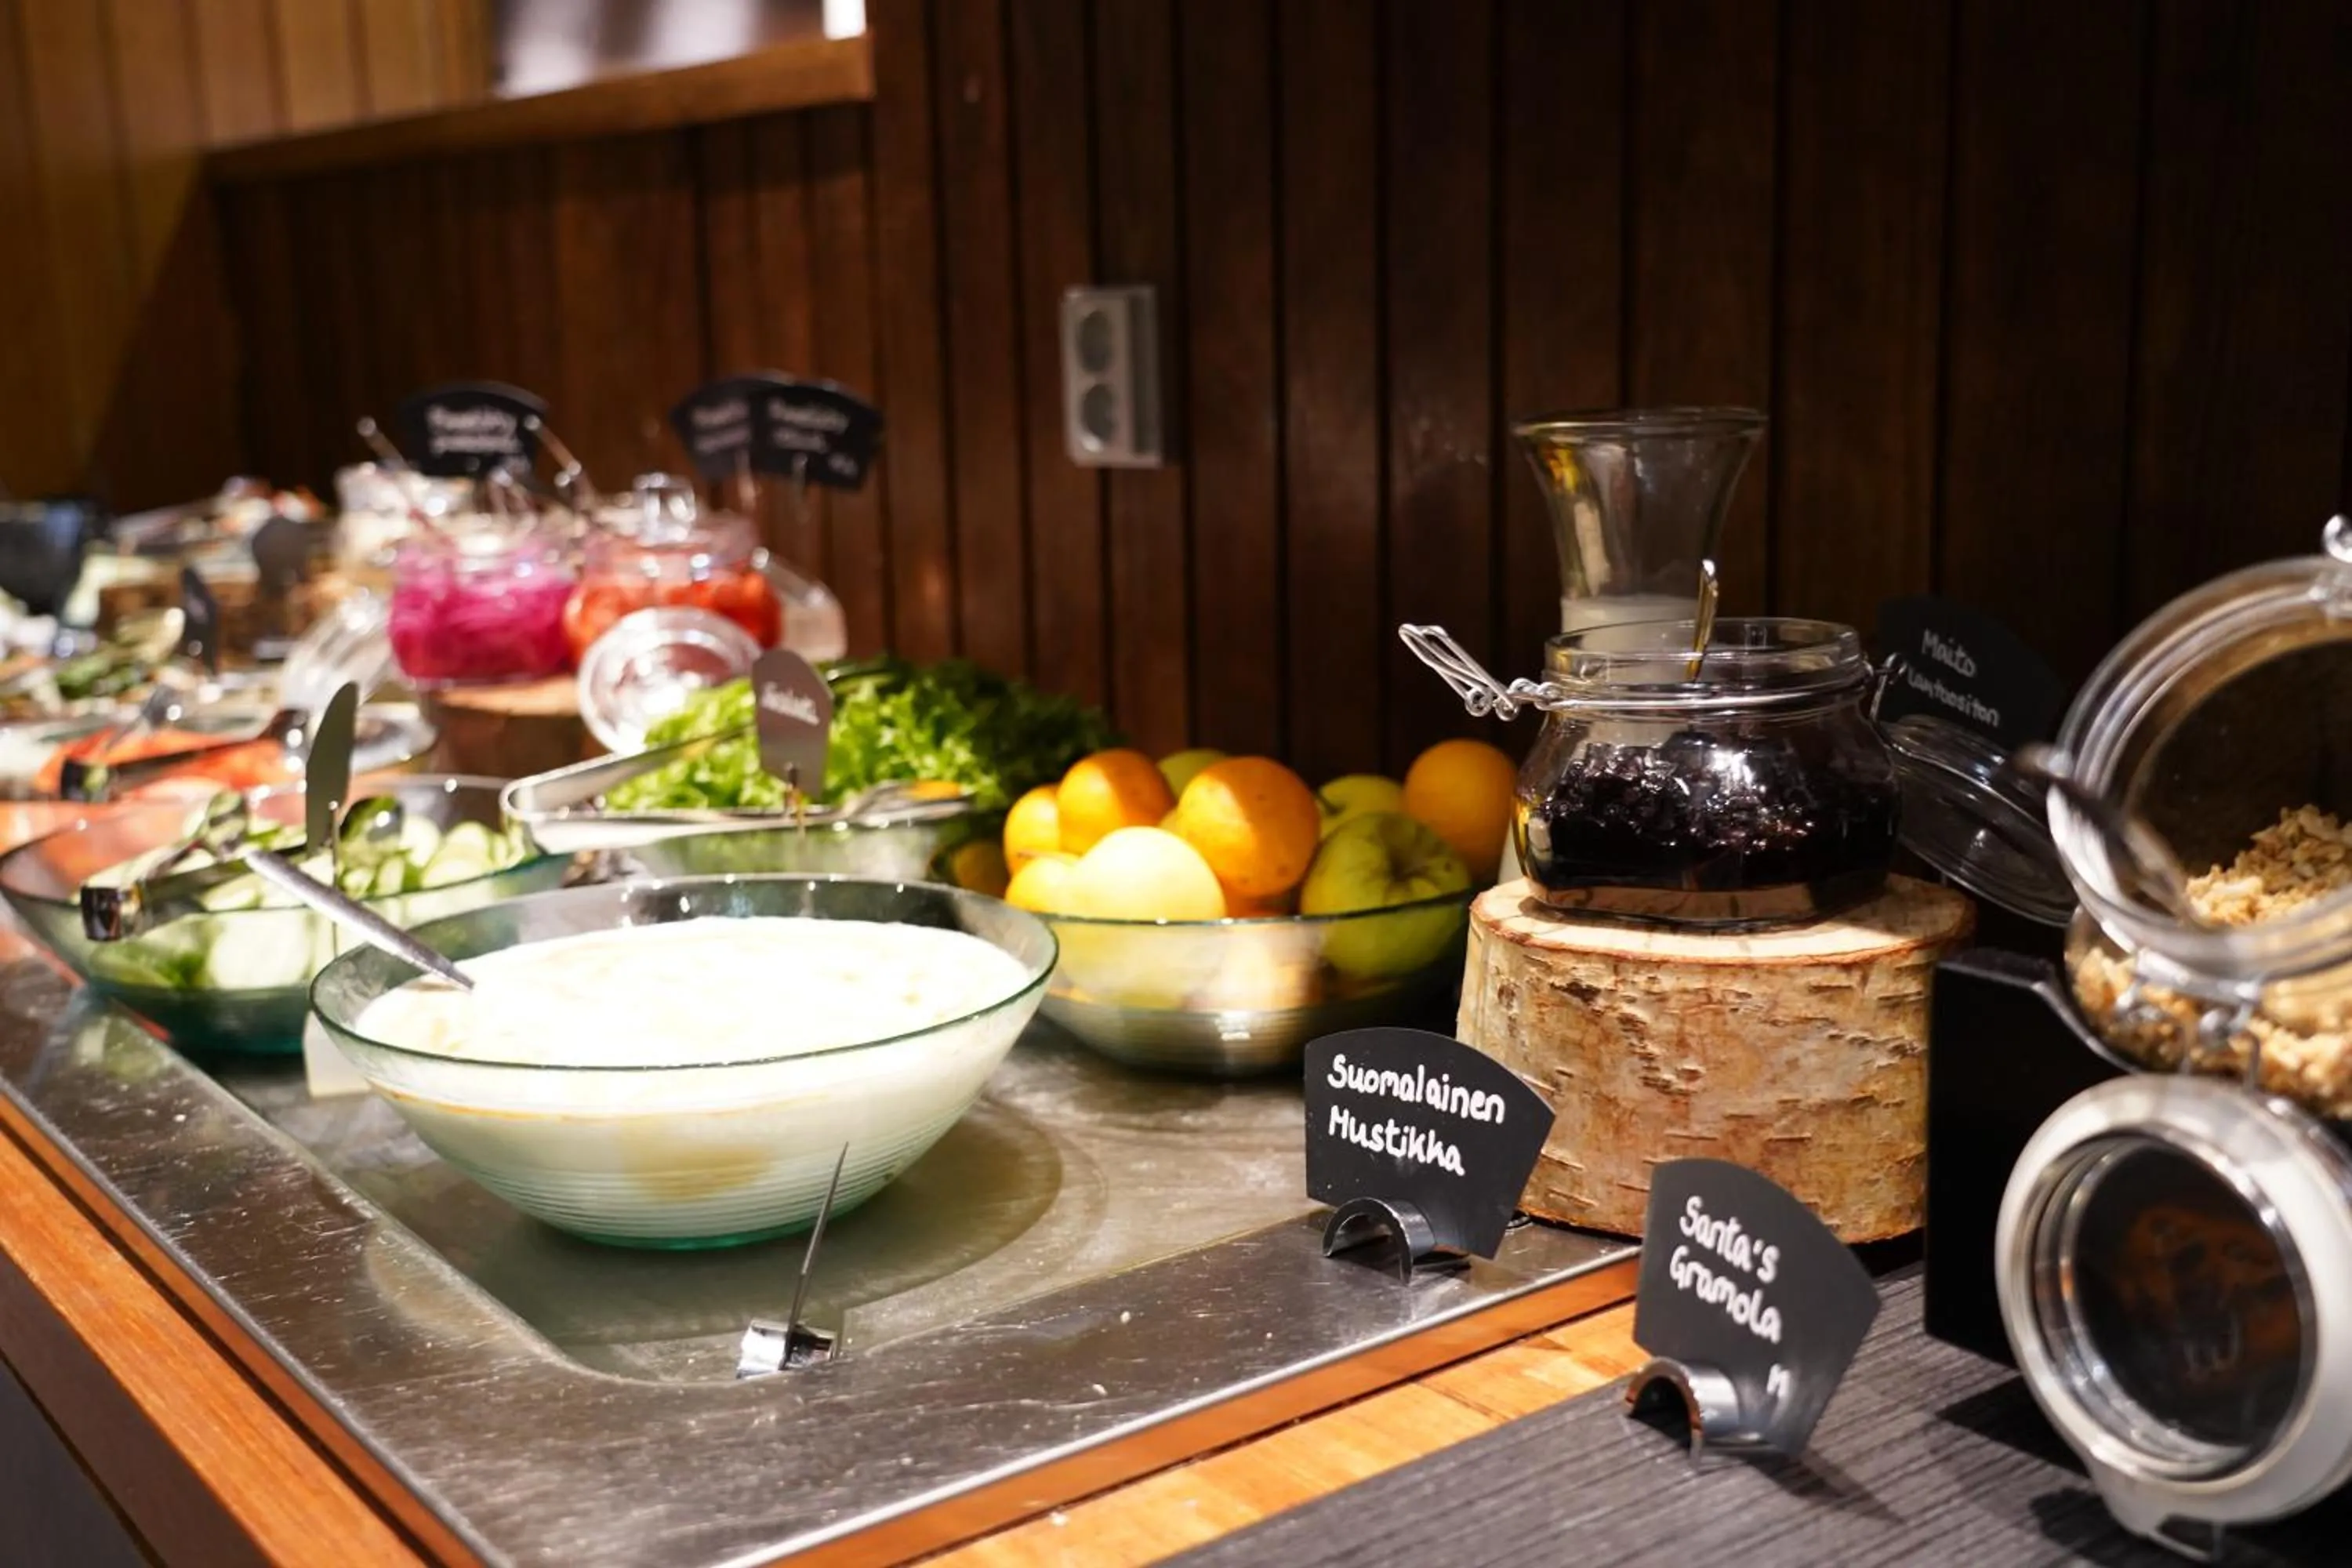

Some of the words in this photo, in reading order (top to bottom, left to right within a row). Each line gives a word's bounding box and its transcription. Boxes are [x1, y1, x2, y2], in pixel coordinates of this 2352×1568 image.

[1921, 627, 1977, 678] Maito
[1327, 1053, 1506, 1124] Suomalainen
[1328, 1104, 1466, 1176] Mustikka
[1679, 1195, 1780, 1283] Santa's
[1669, 1244, 1782, 1345] Granola
